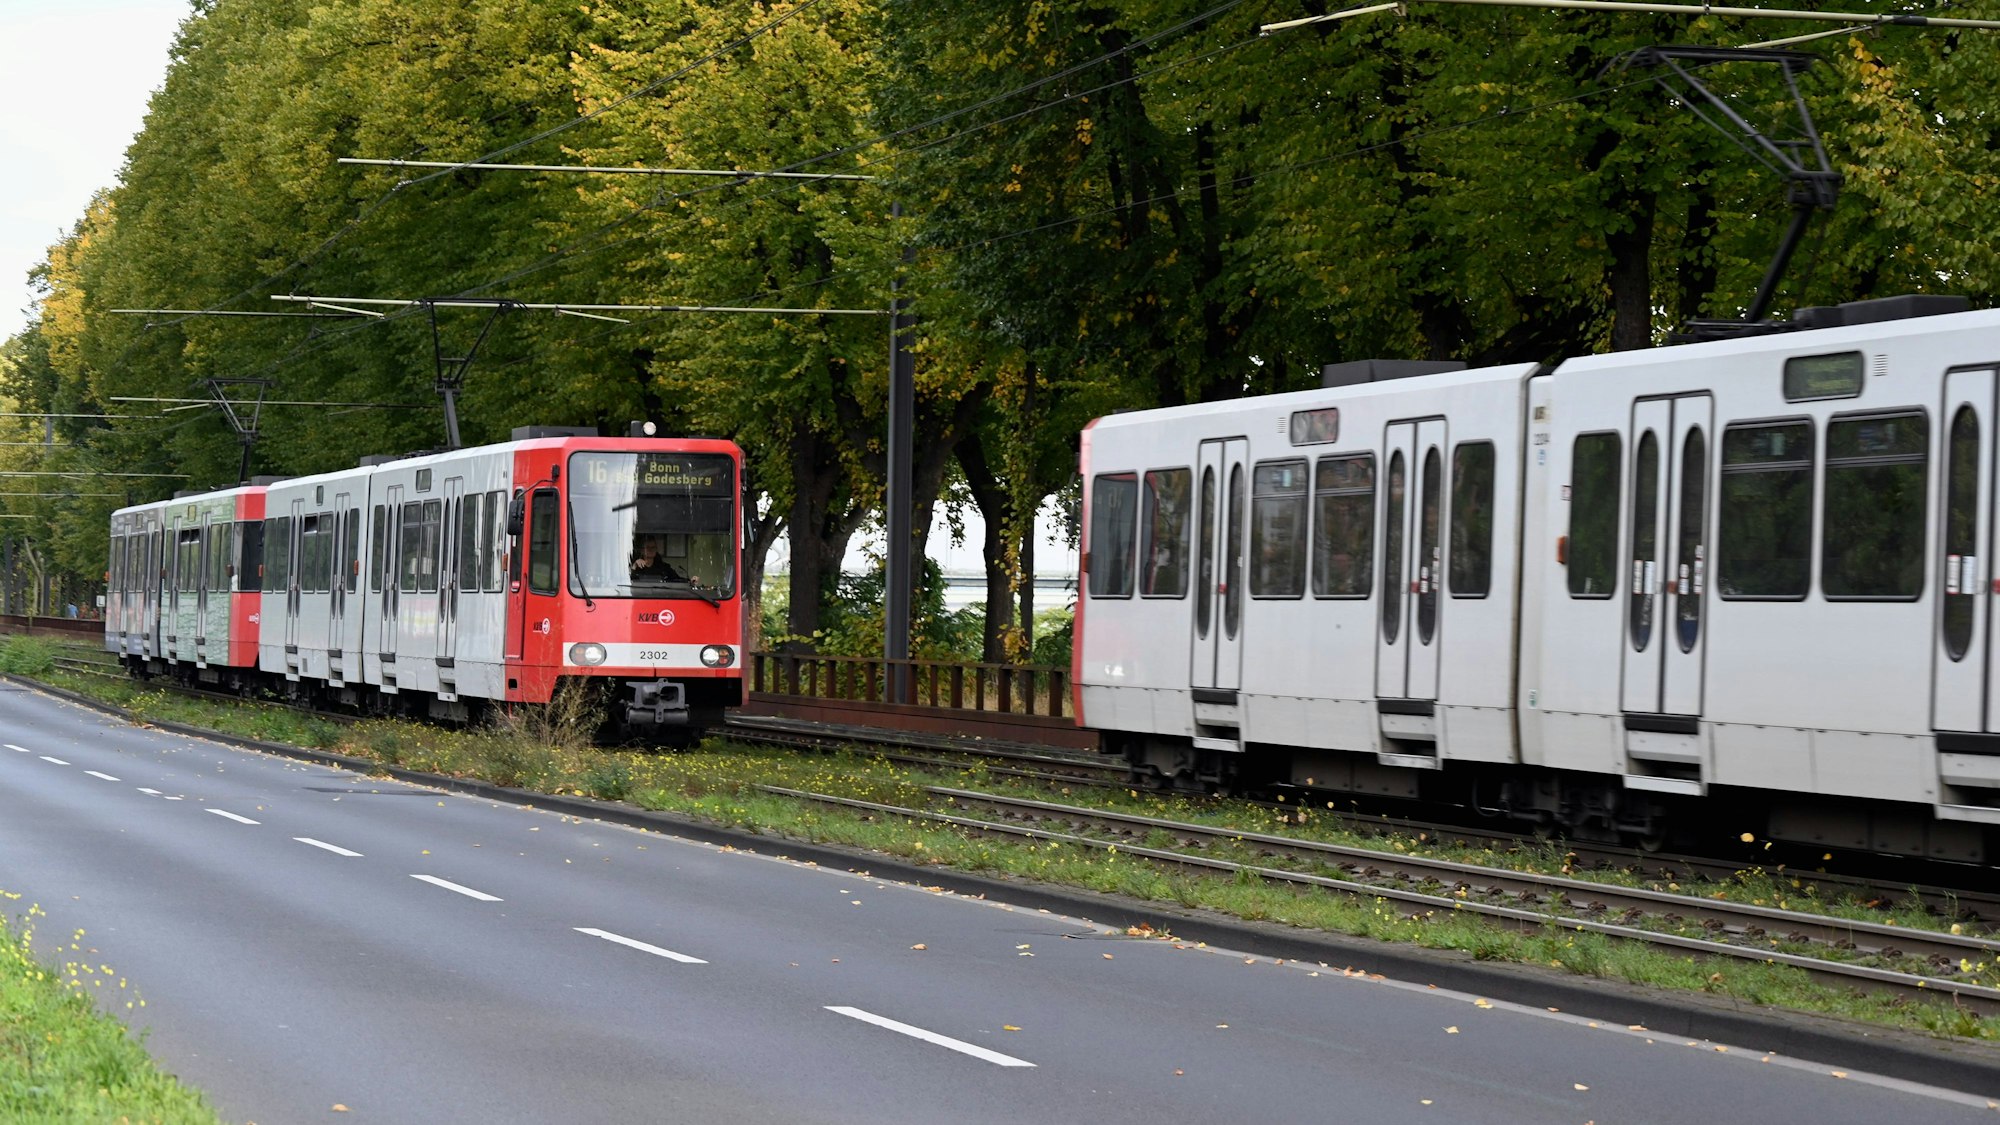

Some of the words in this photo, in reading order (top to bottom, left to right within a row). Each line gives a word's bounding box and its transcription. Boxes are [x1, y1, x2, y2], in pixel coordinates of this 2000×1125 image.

[588, 460, 607, 483] 16
[650, 461, 680, 473] Bonn
[644, 472, 712, 486] Godesberg
[638, 612, 660, 623] KVB
[640, 650, 668, 660] 2302
